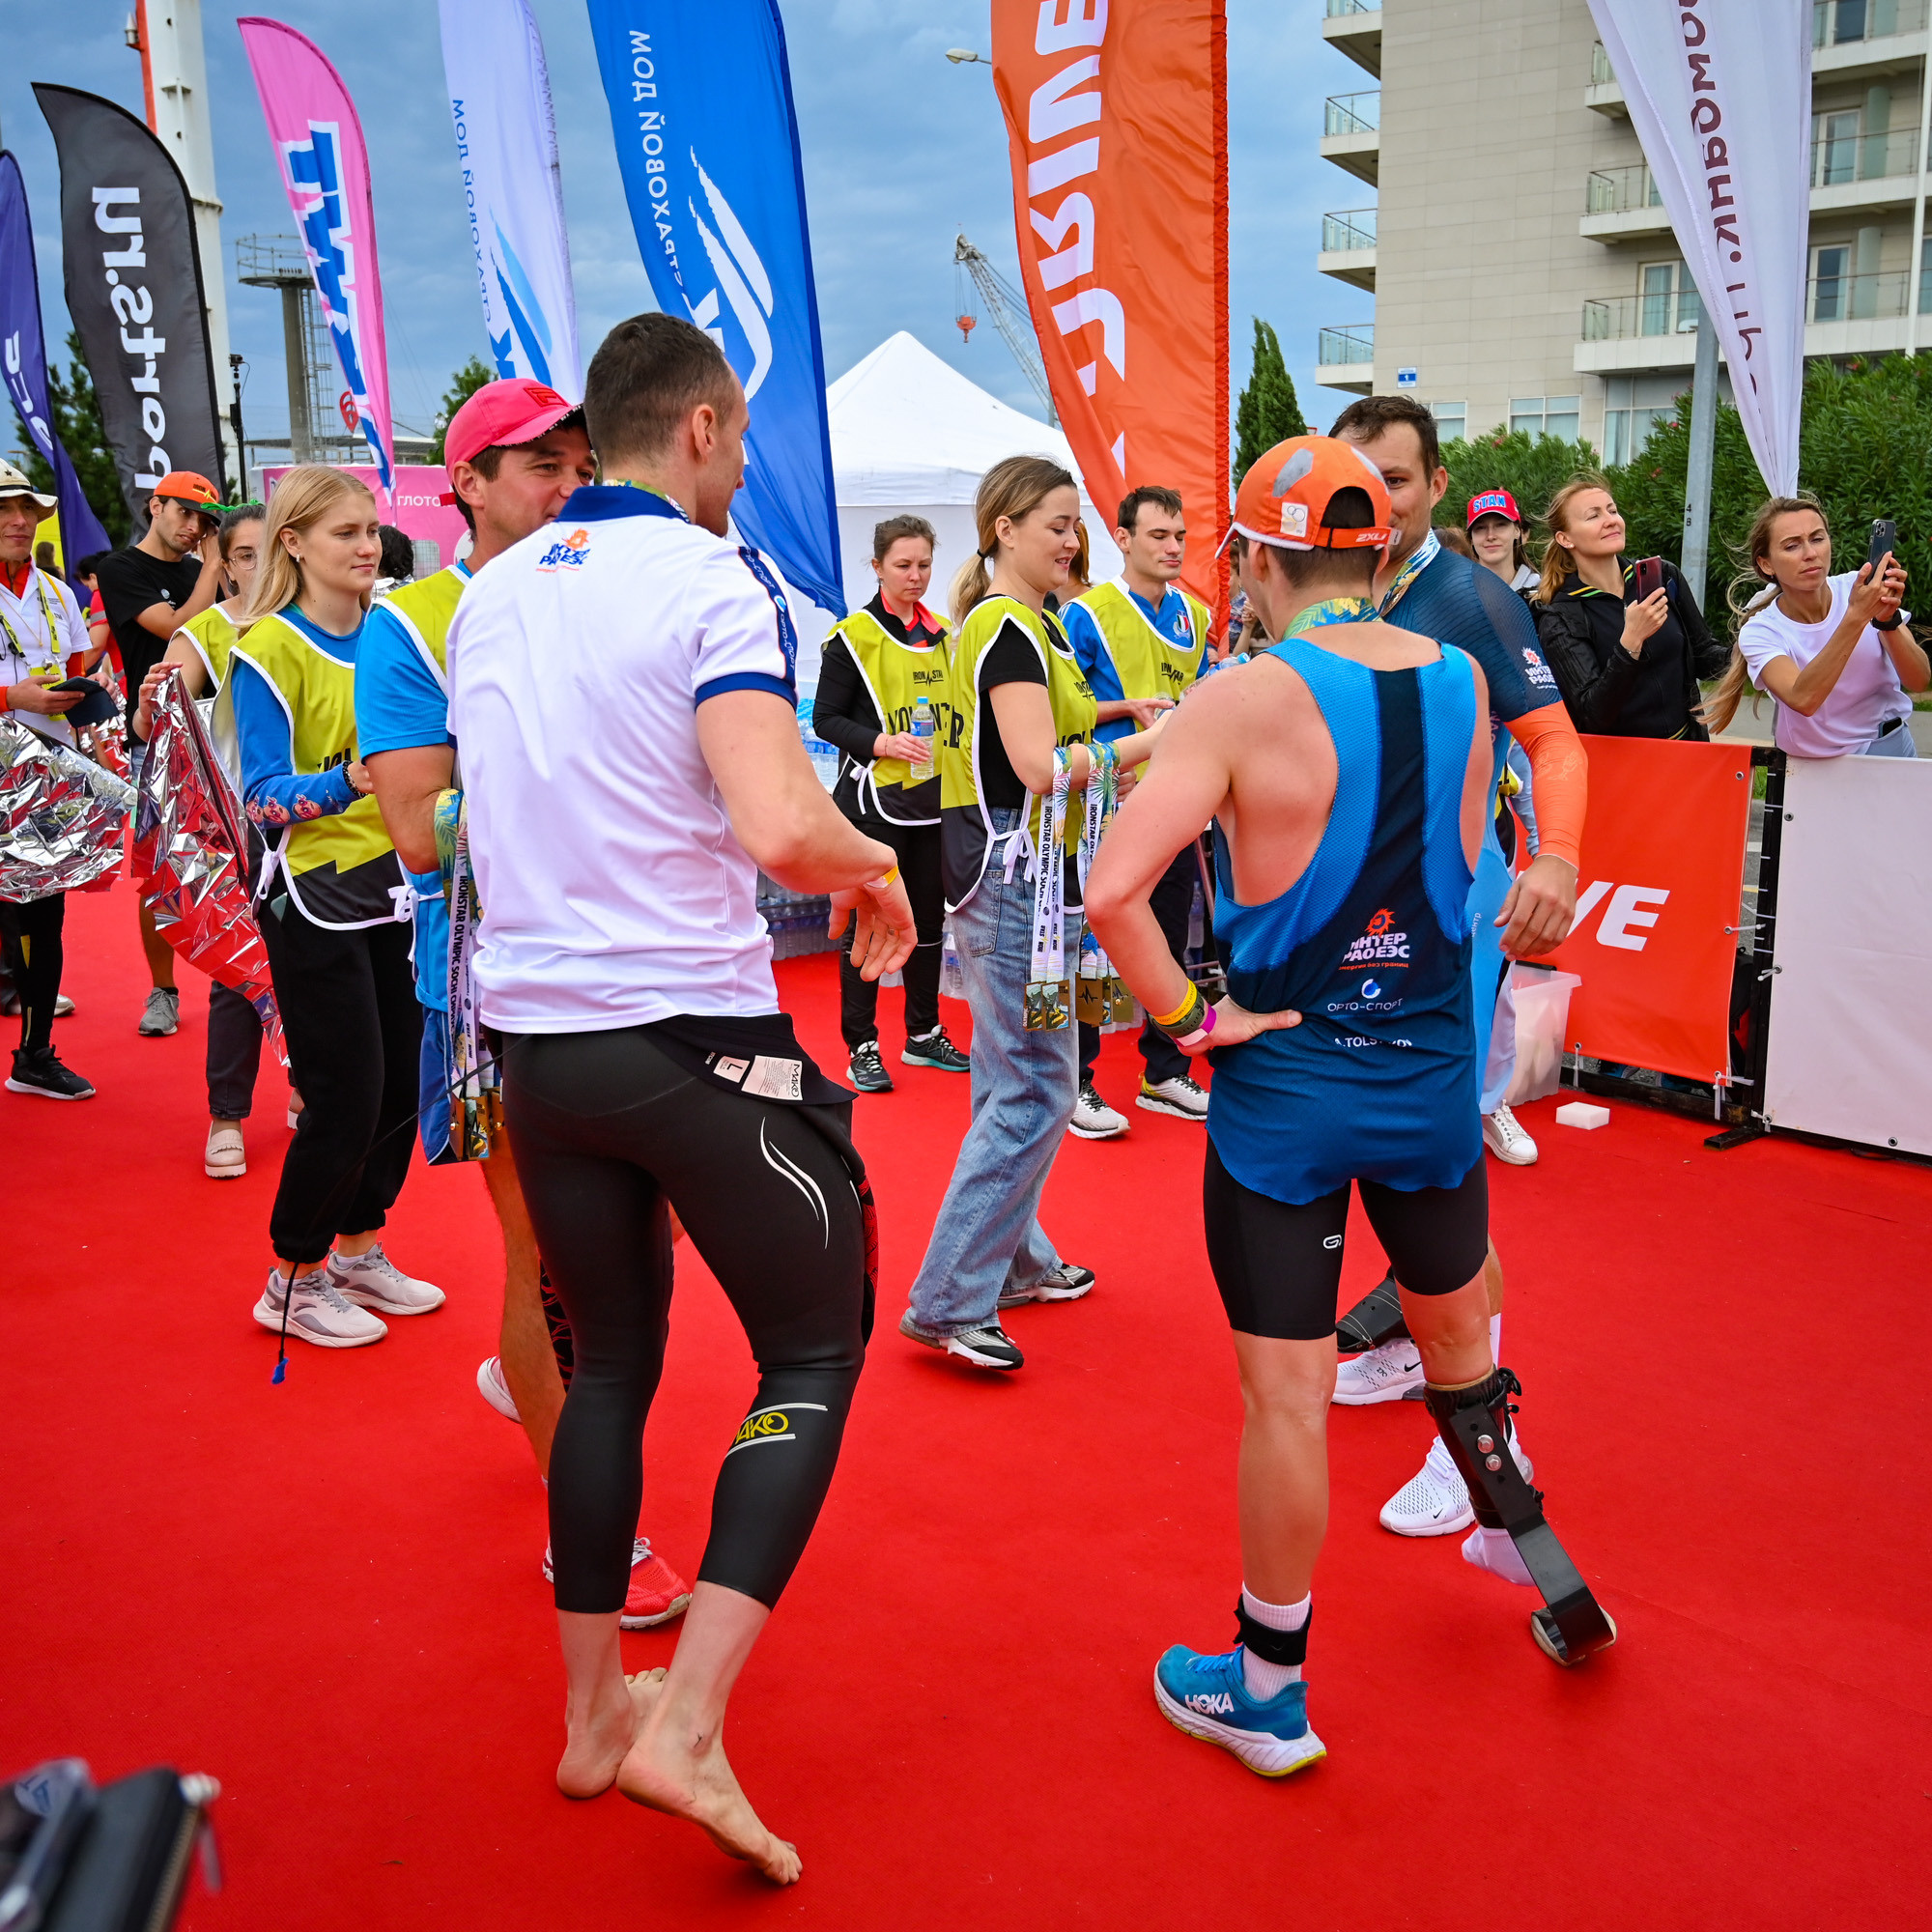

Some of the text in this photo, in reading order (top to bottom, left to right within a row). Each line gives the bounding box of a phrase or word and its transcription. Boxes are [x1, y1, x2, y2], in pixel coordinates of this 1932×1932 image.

[397, 496, 443, 506] ГЛОТО
[1473, 494, 1507, 513] STAN
[1042, 806, 1053, 842] IRONSTAR
[1089, 804, 1098, 839] IRONSTAR
[1040, 843, 1051, 875] OLYMPIC
[455, 875, 469, 923] IRONSTAR
[452, 924, 466, 965] OLYMPIC
[1350, 932, 1407, 951] ИНТЕР
[1327, 998, 1404, 1012] ОРТО-СПОРТ
[735, 1411, 789, 1445] AKO
[1184, 1691, 1236, 1715] HOKA
